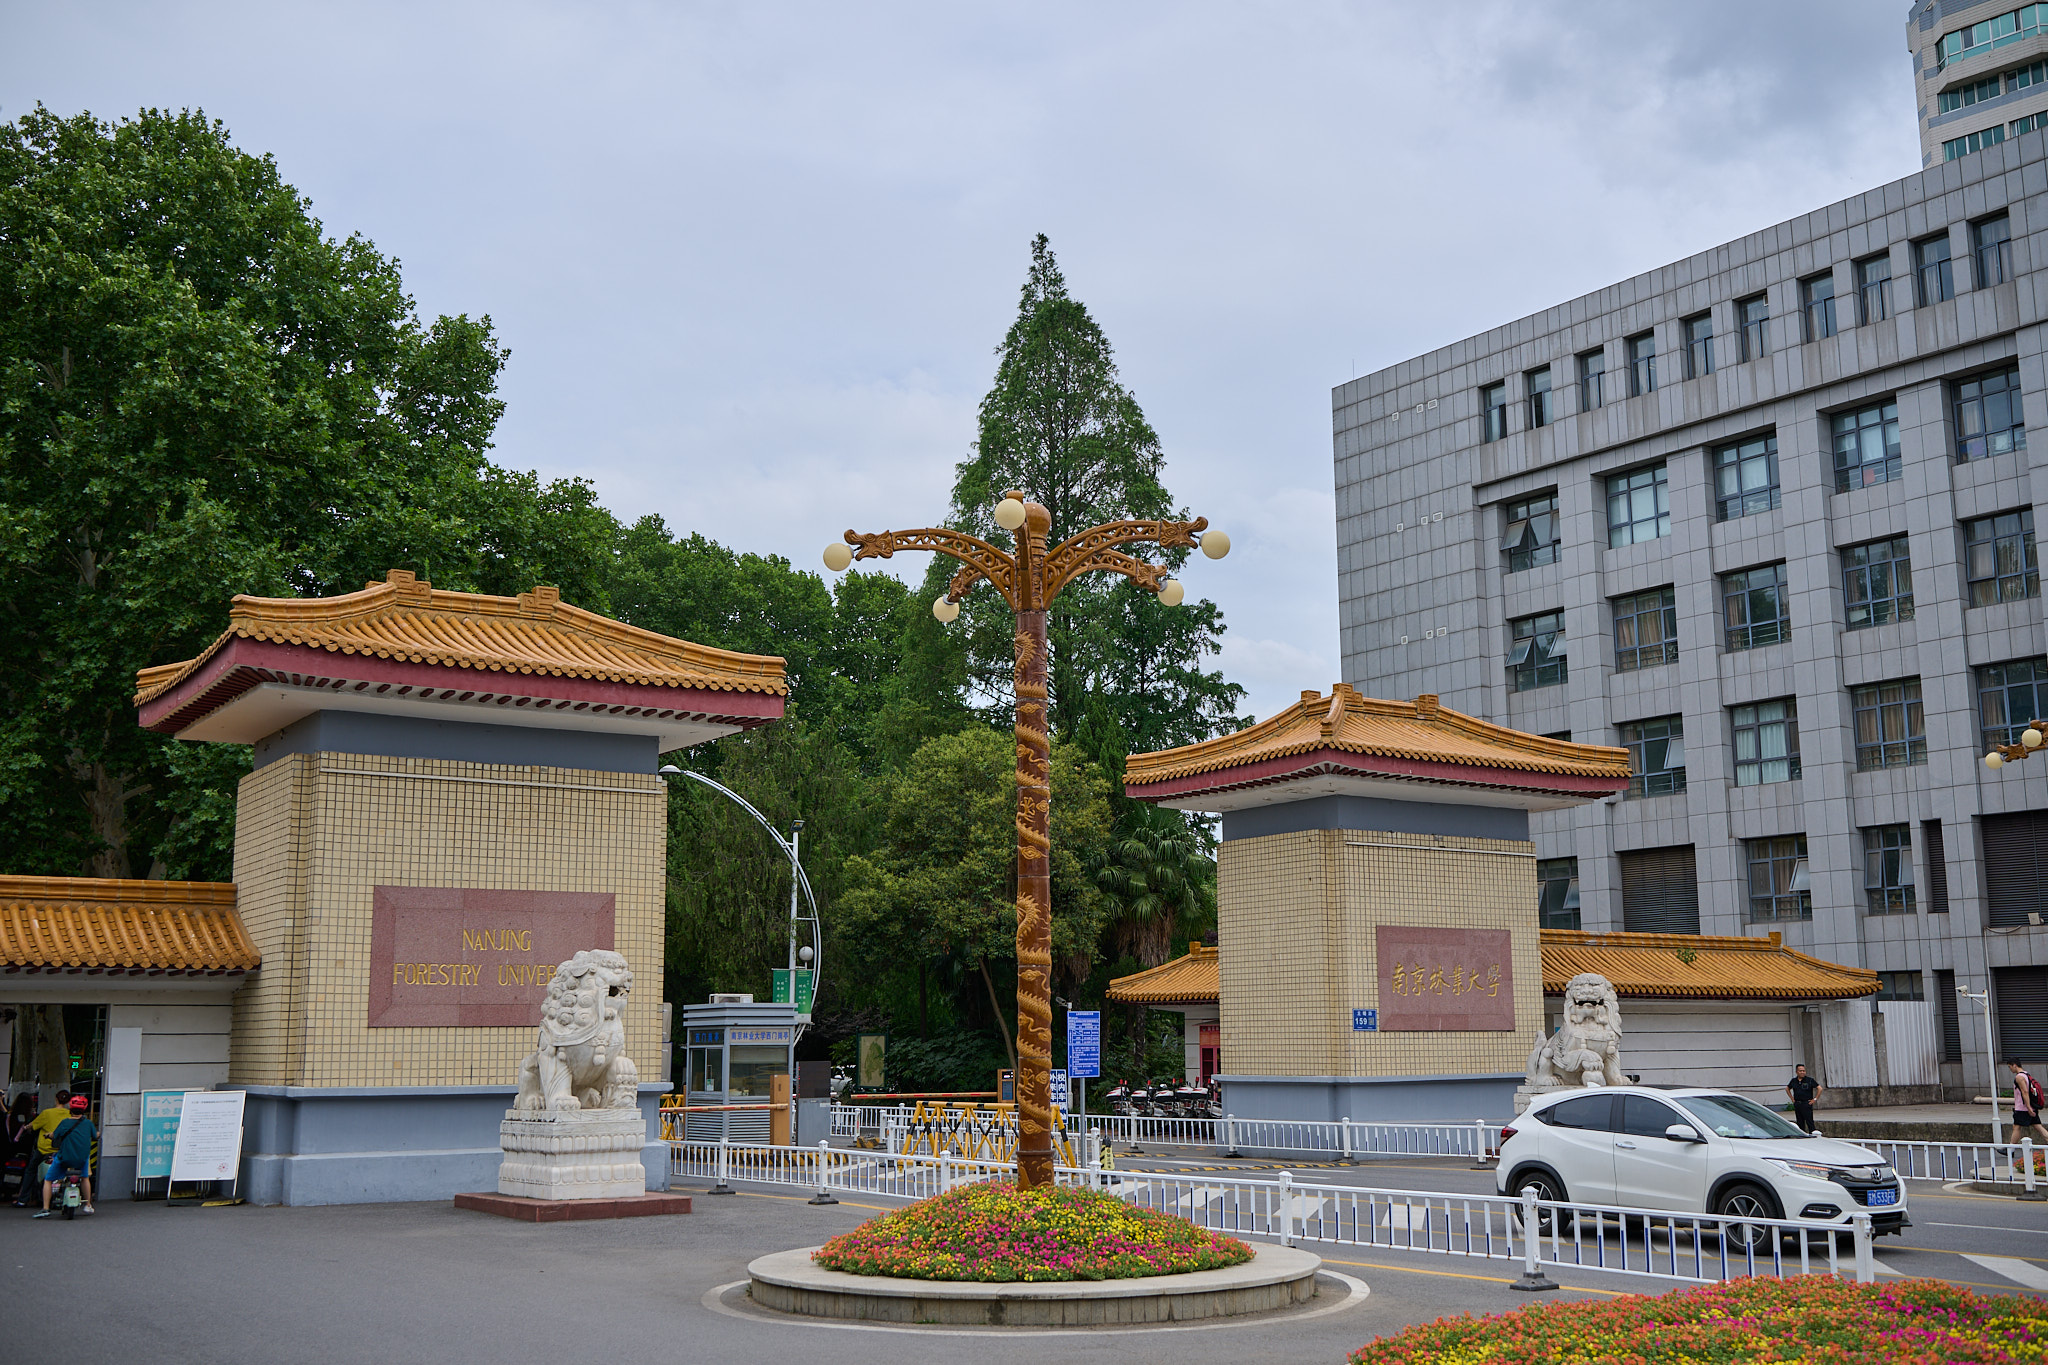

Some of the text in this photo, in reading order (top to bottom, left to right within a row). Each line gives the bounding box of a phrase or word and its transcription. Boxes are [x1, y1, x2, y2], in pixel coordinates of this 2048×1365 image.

[463, 929, 532, 951] NANJING
[393, 963, 482, 986] FORESTRY
[1355, 1017, 1368, 1025] 159
[731, 1031, 789, 1041] 南京林业大学西门岗亭
